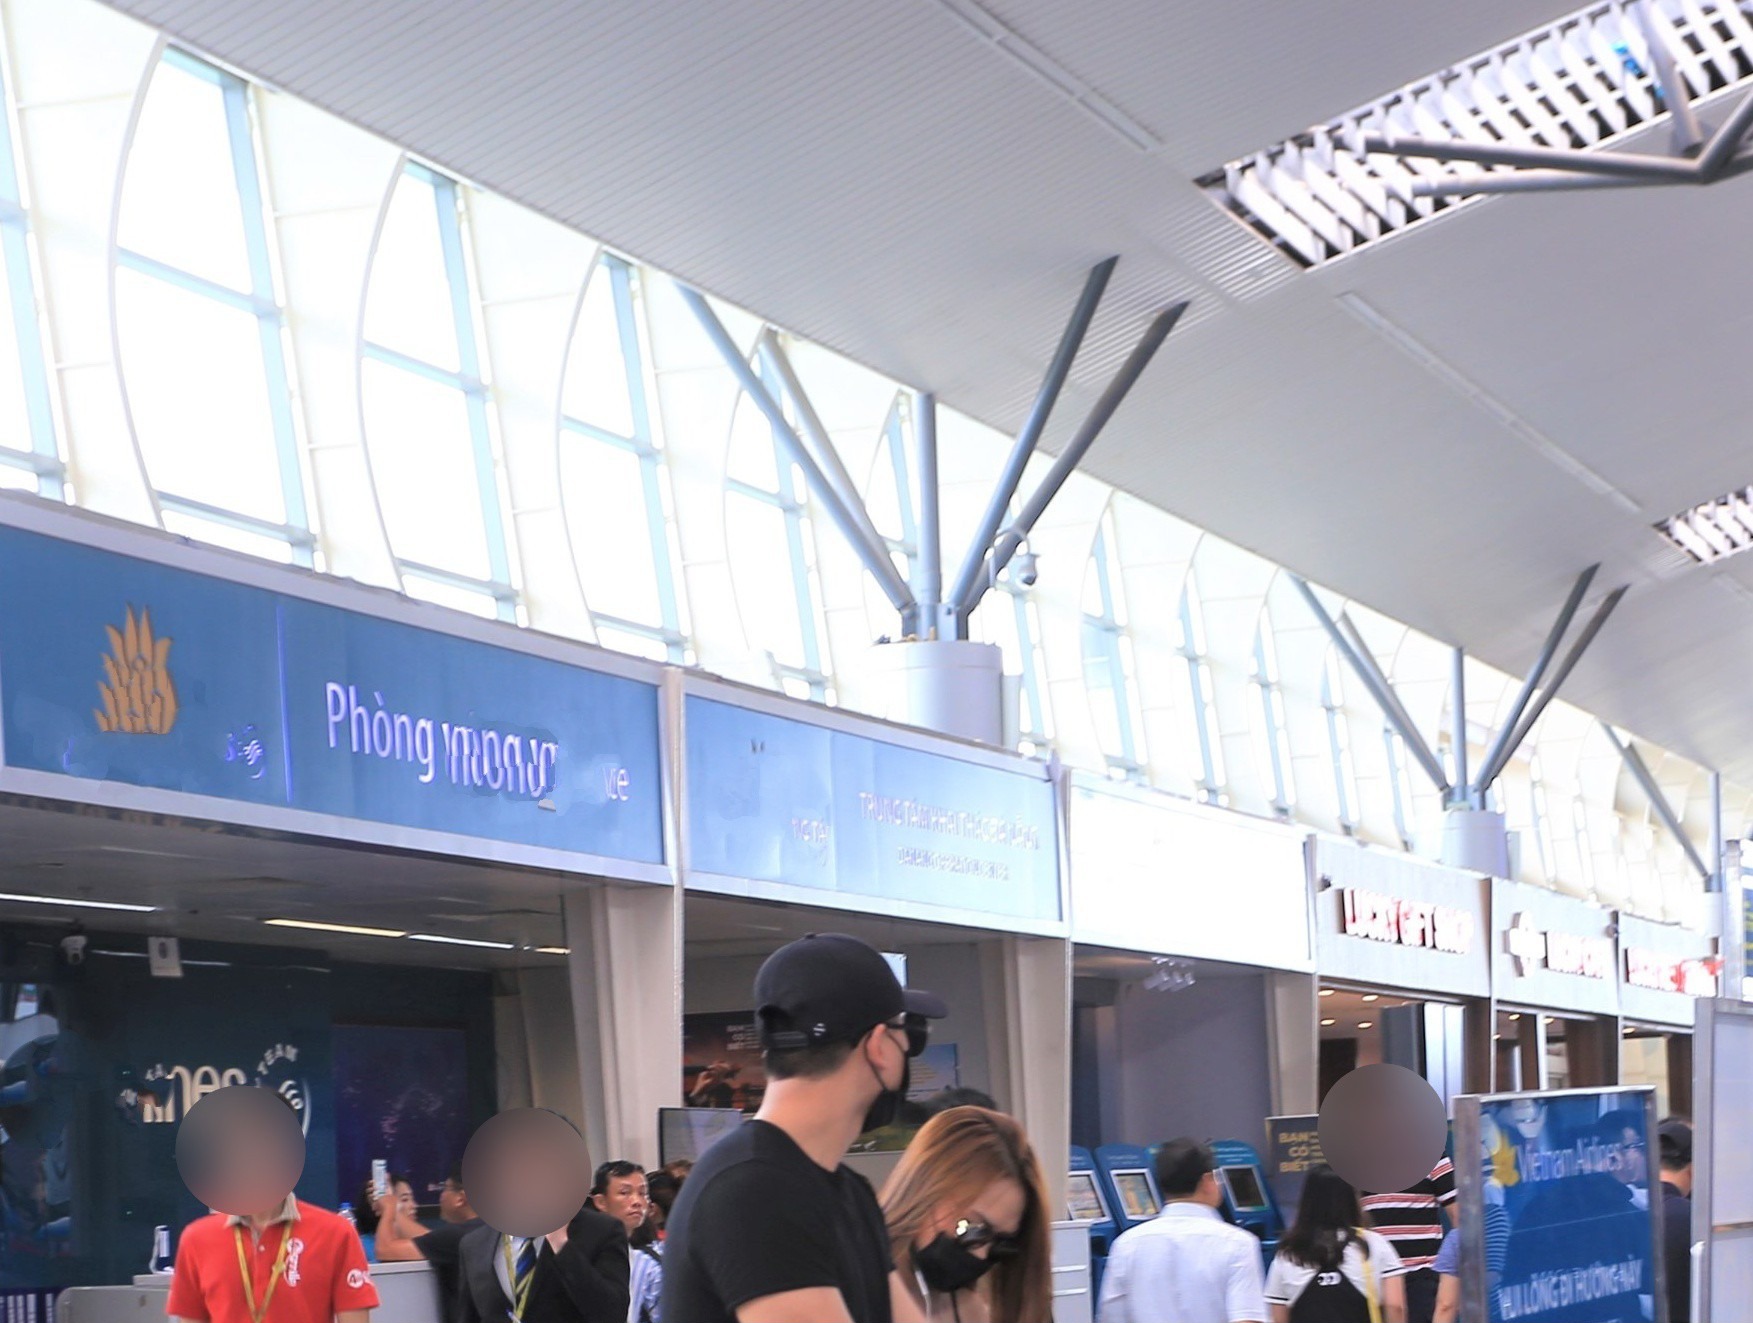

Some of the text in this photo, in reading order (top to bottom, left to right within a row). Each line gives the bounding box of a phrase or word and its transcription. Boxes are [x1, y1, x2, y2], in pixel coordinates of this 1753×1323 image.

[326, 682, 435, 783] Phòng
[1514, 1136, 1624, 1183] Vietnam Airlines
